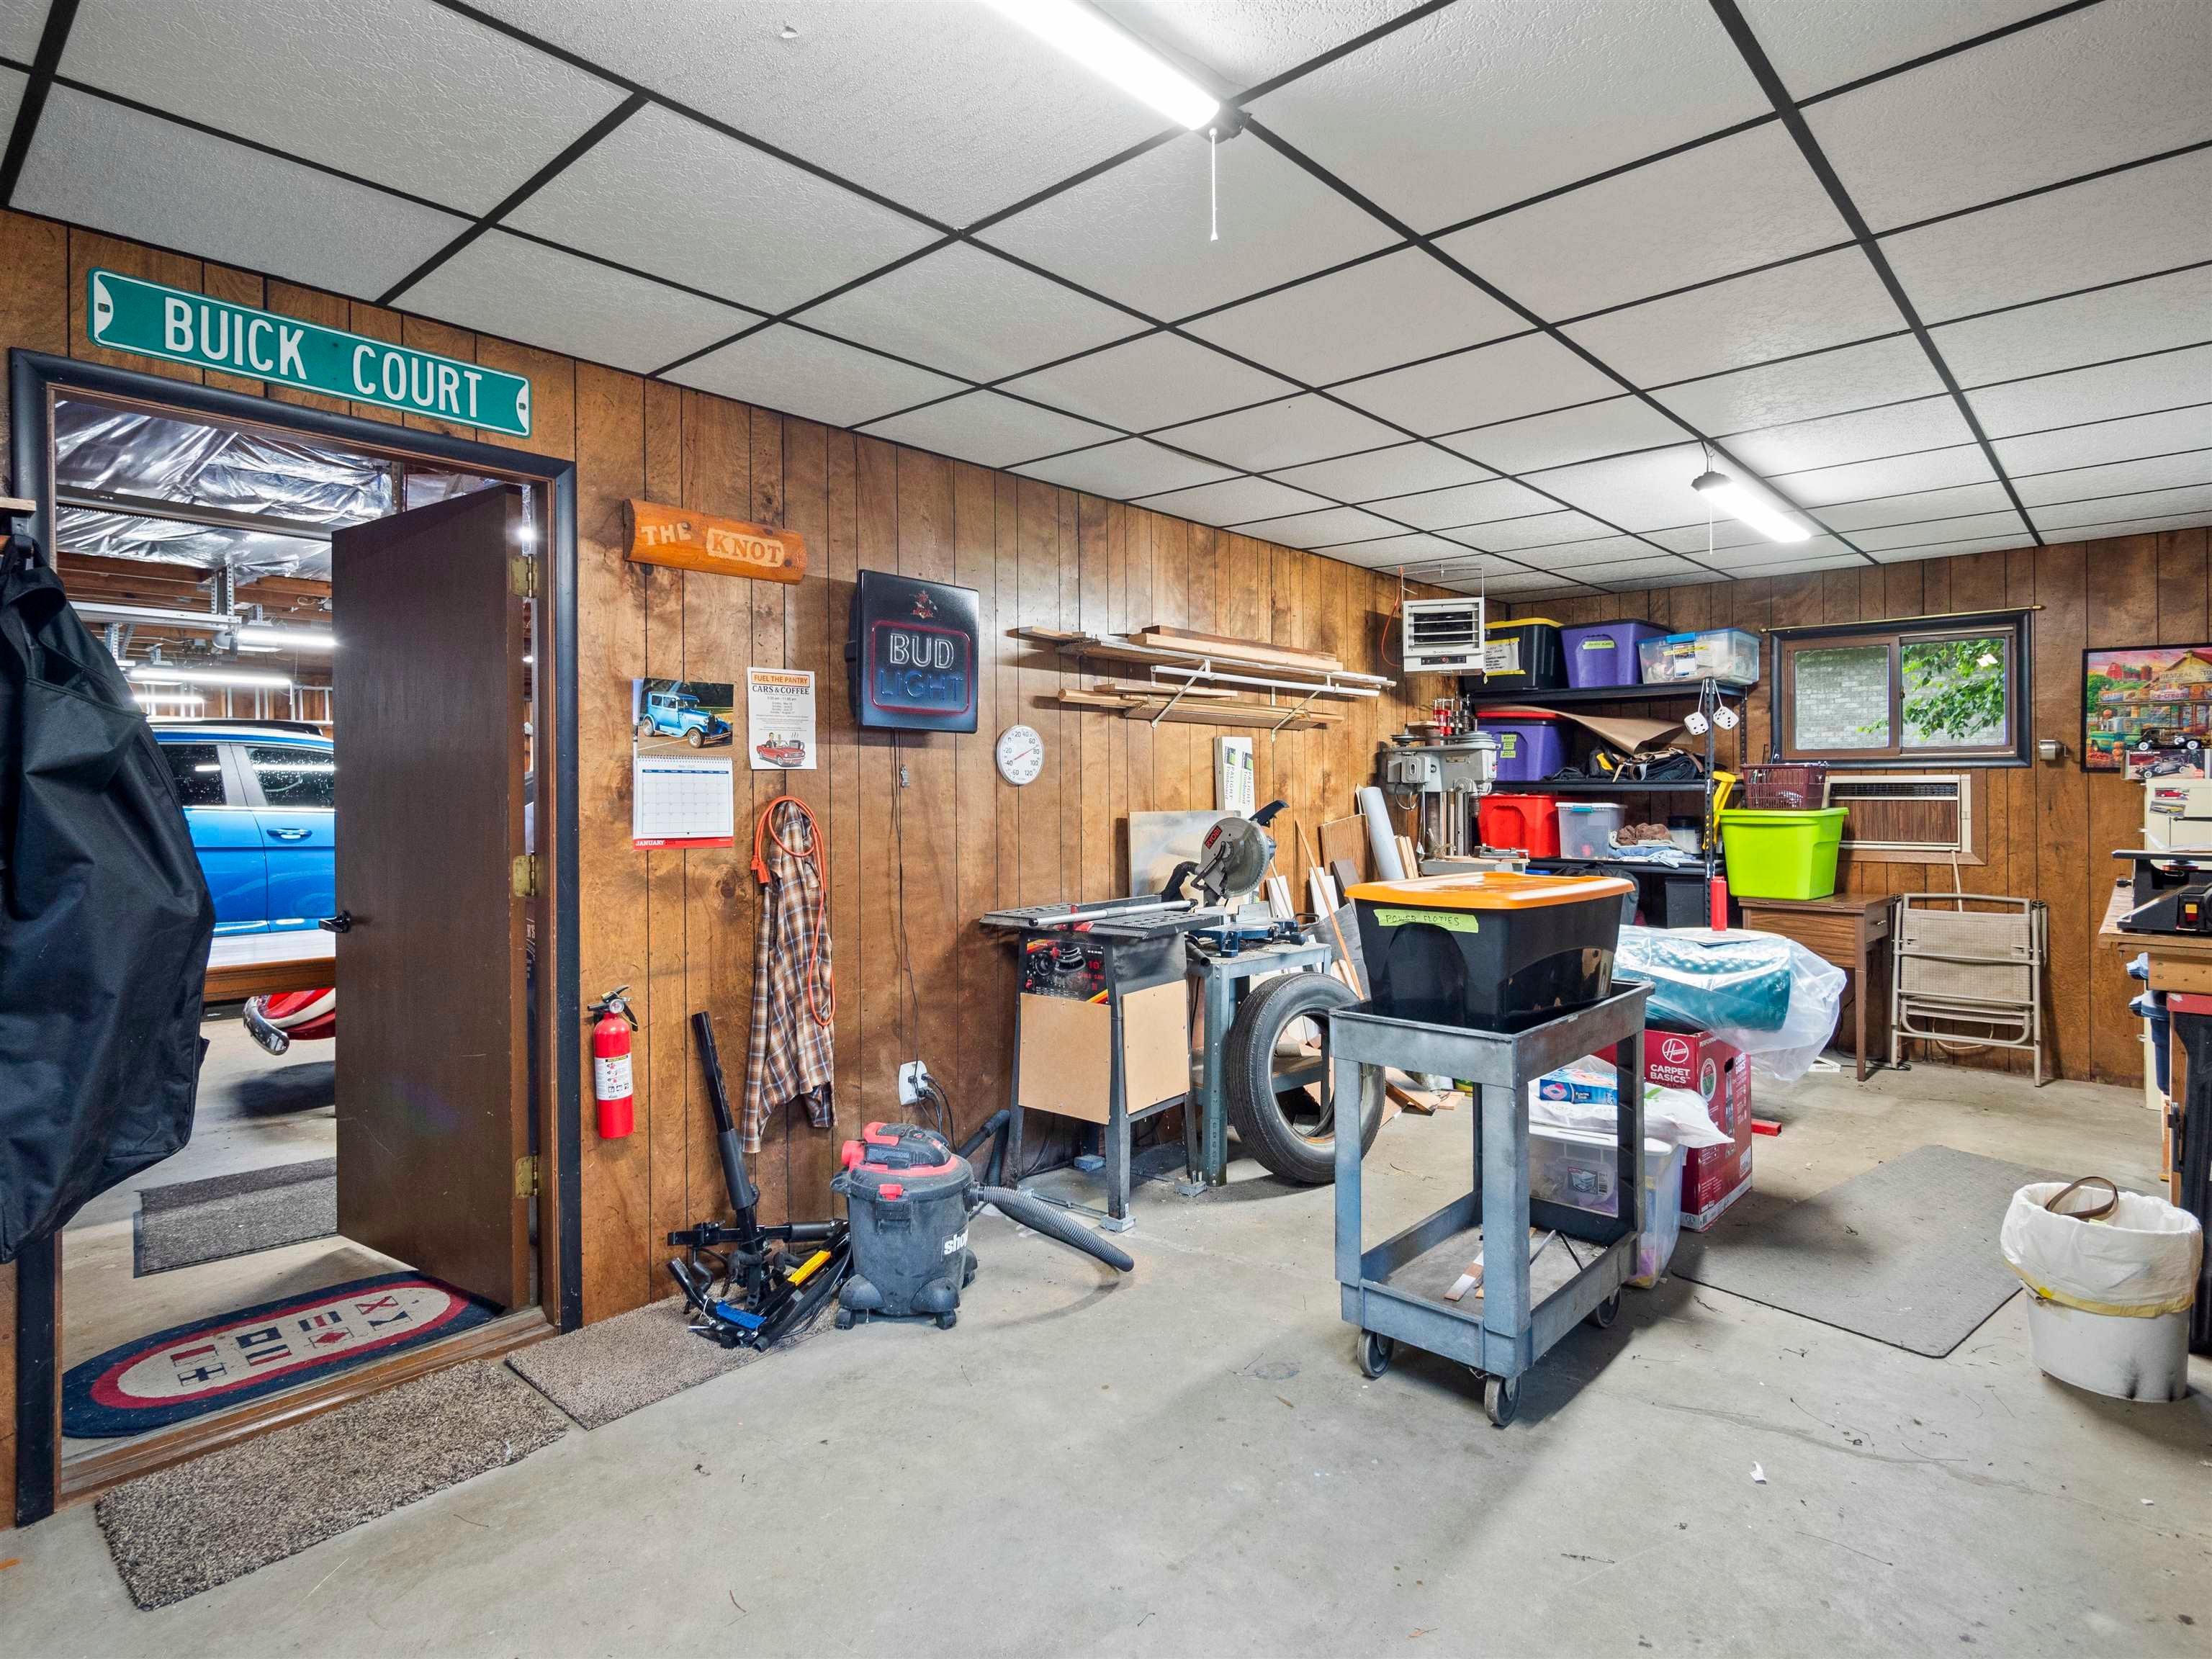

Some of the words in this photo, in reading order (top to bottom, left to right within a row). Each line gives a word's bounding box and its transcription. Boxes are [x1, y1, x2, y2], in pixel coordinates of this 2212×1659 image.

[165, 297, 307, 379] BUICK
[353, 345, 482, 418] COURT
[641, 523, 691, 546] THE
[712, 533, 781, 564] KNOT
[890, 633, 954, 668] BUD
[879, 669, 963, 701] LIGHT
[1205, 827, 1221, 848] RYOBI
[1650, 1064, 1691, 1076] CARPET
[1650, 1071, 1686, 1084] BASICS
